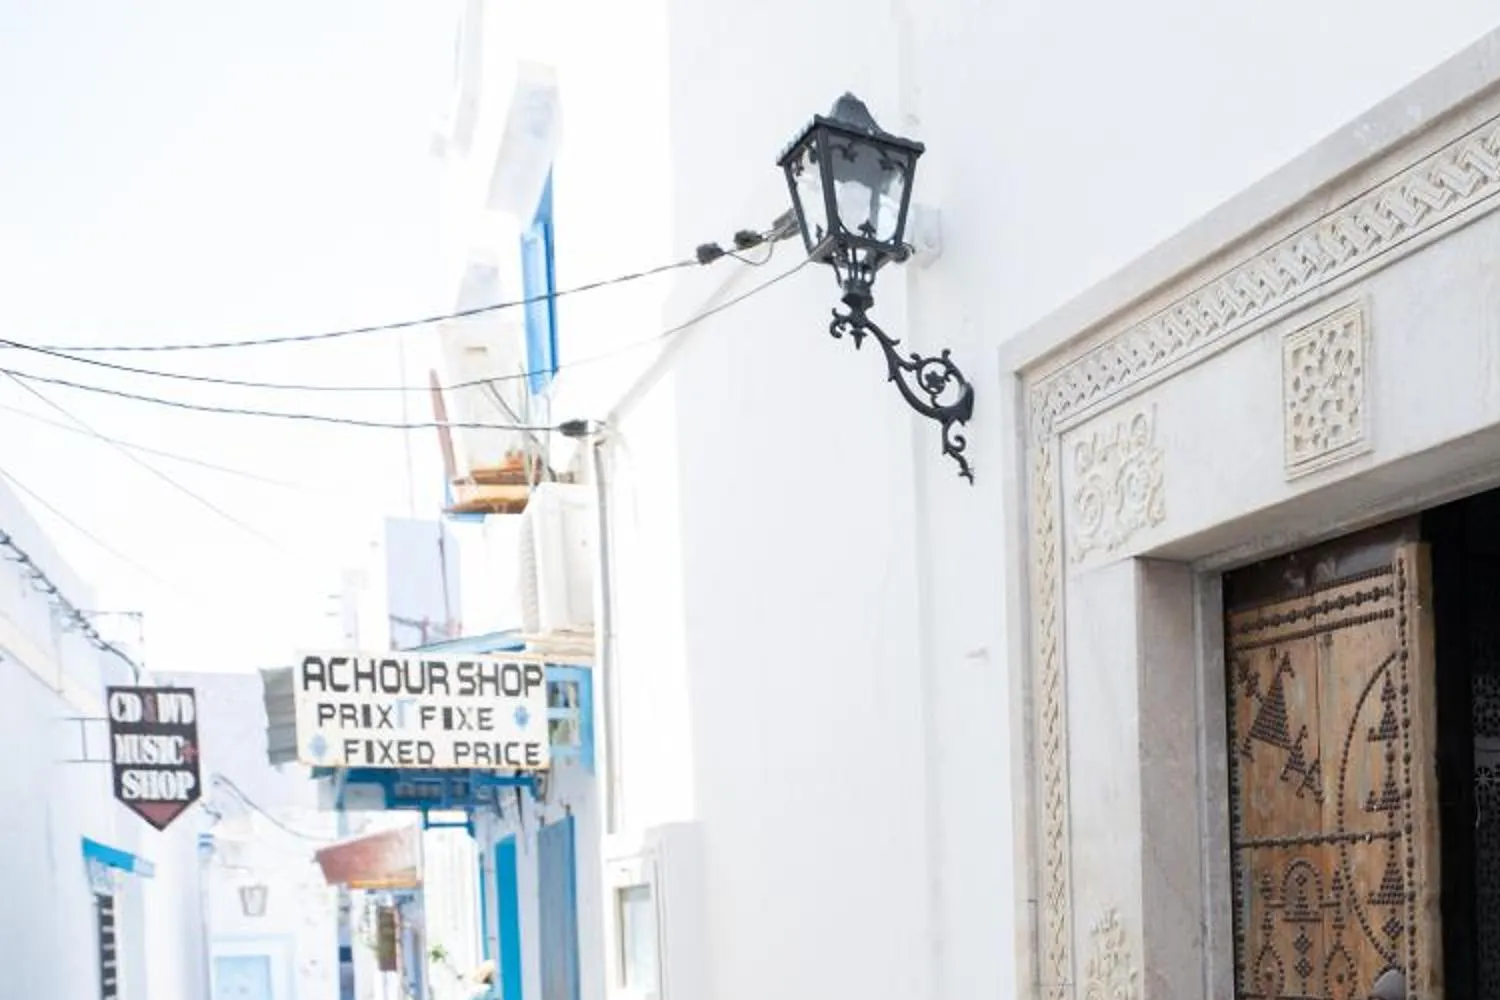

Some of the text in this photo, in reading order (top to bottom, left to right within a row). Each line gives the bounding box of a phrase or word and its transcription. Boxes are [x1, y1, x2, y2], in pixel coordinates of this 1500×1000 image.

[303, 656, 543, 697] ACHOUR SHOP
[317, 703, 494, 731] PRIX FIXE
[342, 739, 541, 767] FIXED PRICE
[121, 769, 195, 800] SHOP
